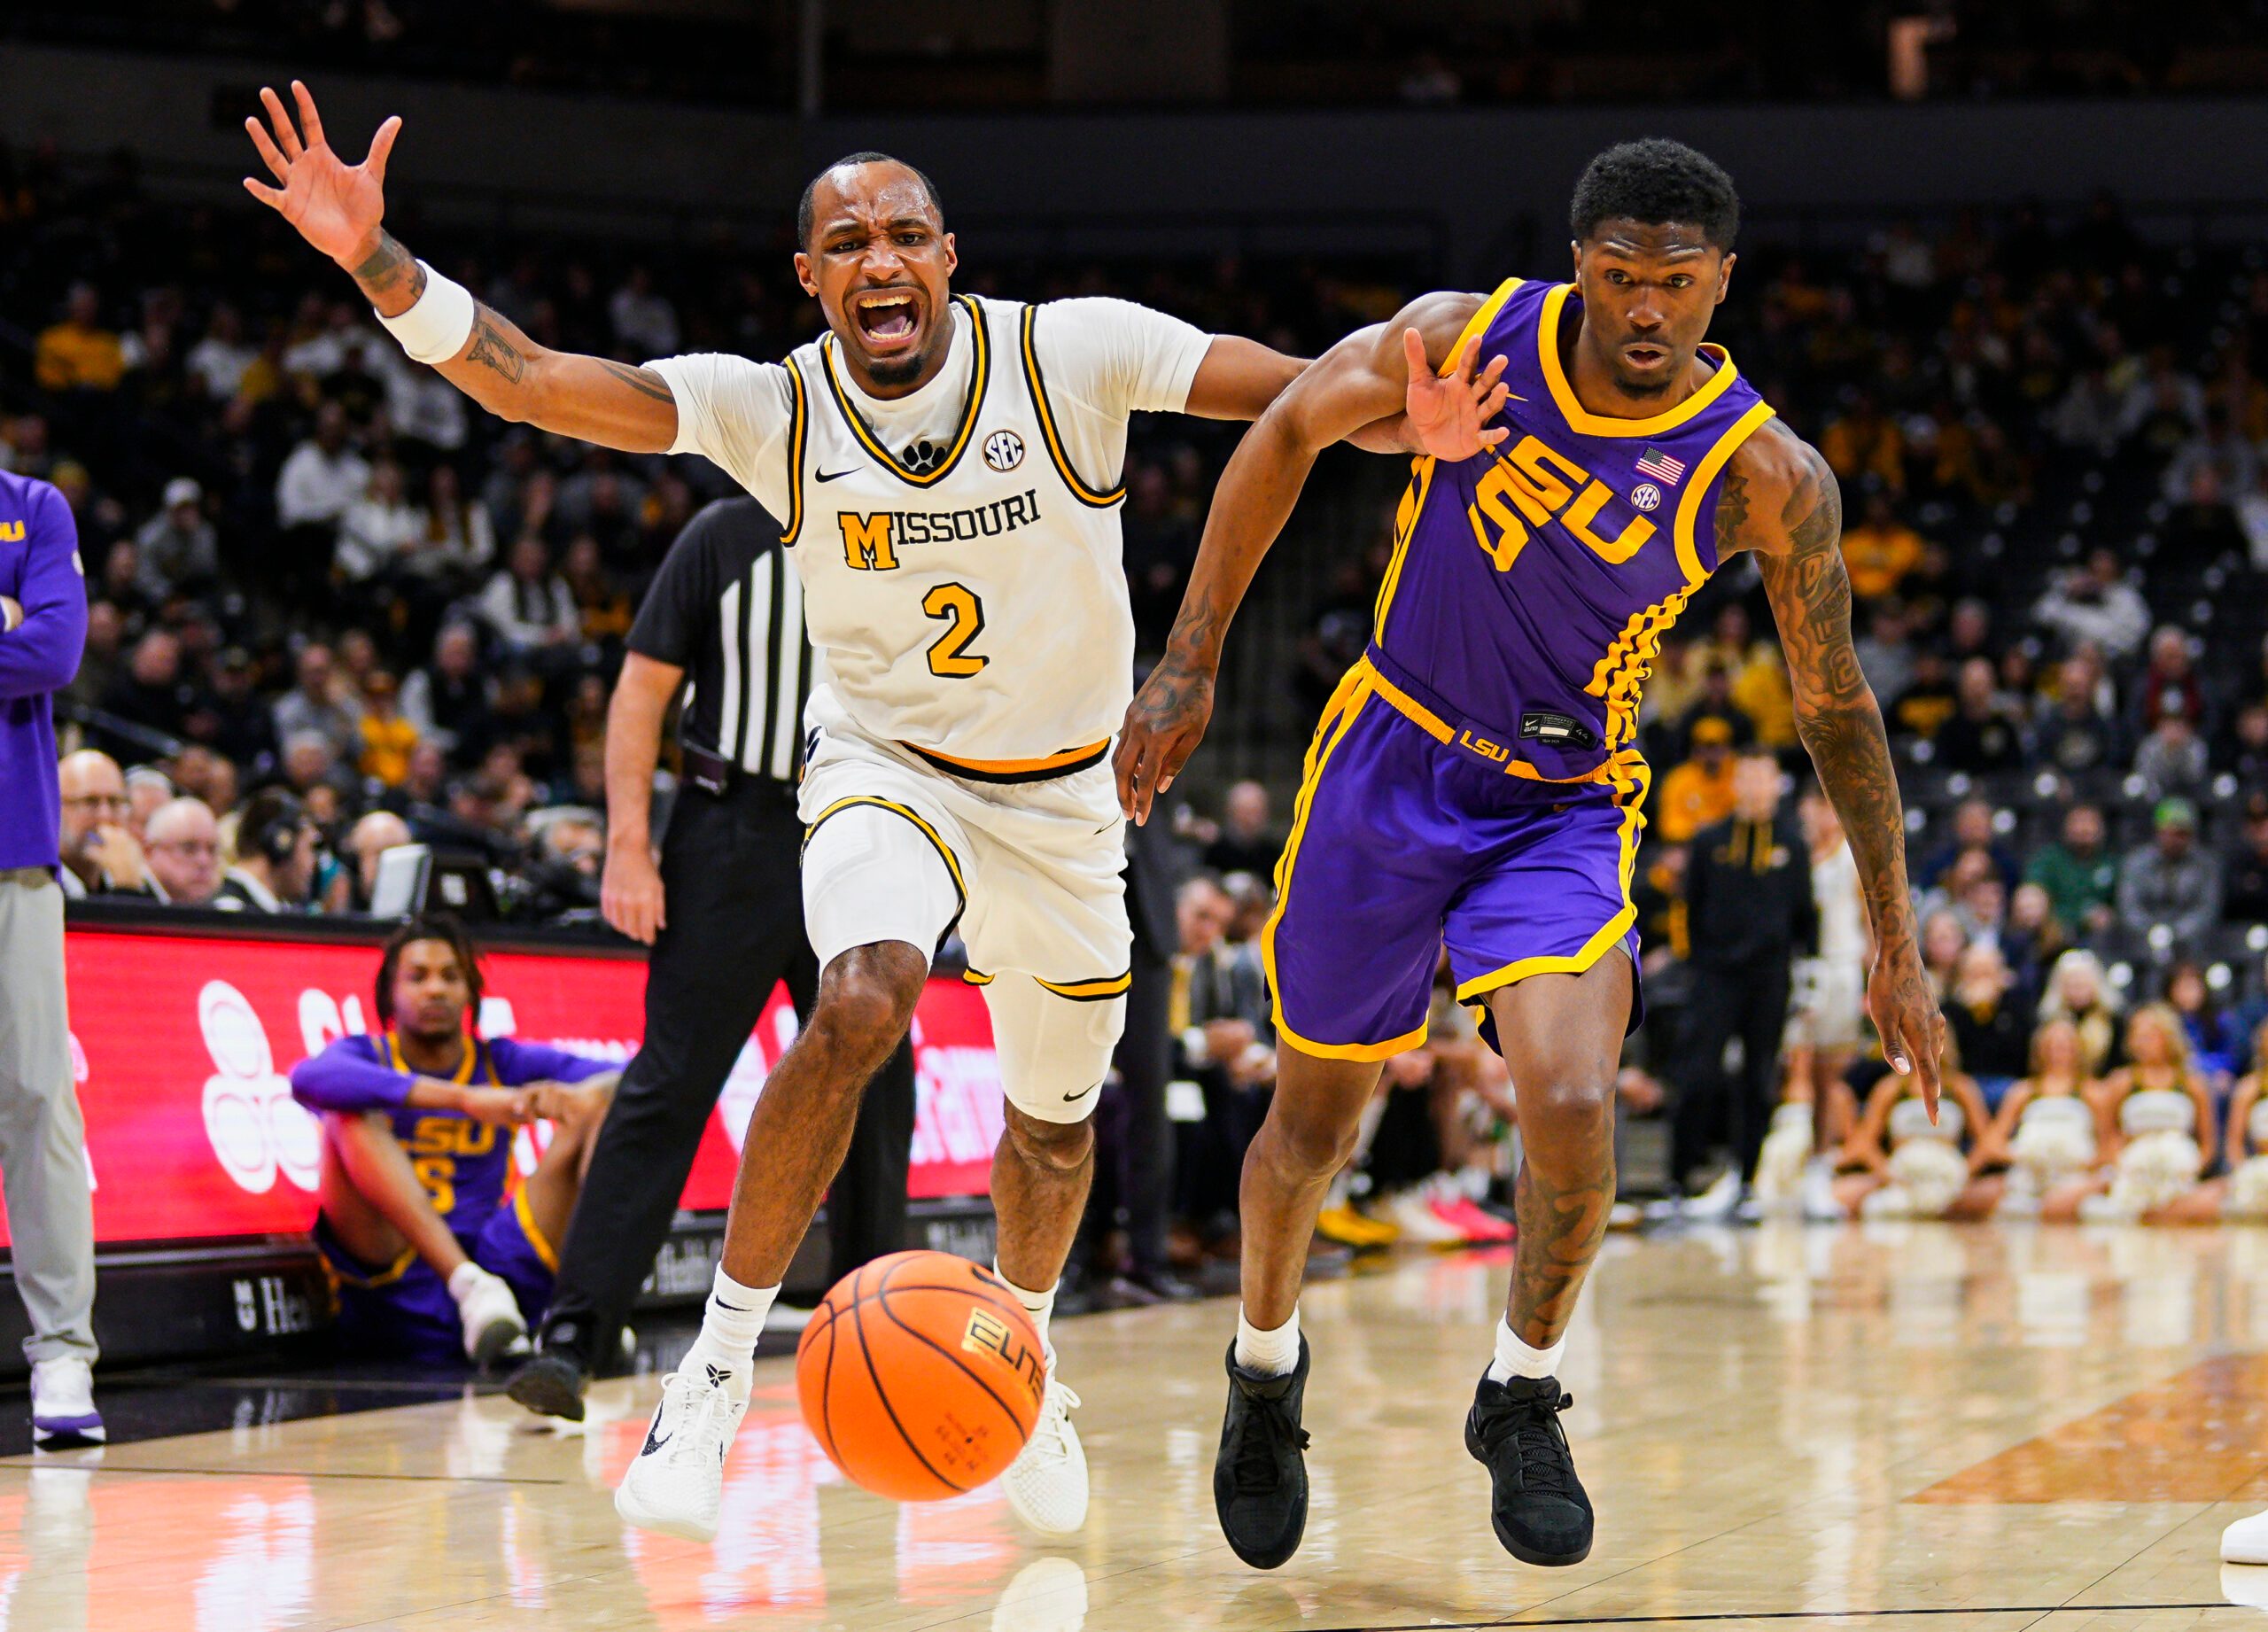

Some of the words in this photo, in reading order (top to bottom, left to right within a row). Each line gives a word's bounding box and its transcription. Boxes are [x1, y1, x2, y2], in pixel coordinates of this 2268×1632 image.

[983, 431, 1023, 470] SEC
[1485, 435, 1658, 564] SU
[1633, 486, 1658, 509] SEC
[837, 489, 1042, 571] MISSOURI
[921, 581, 990, 680] 2
[1460, 729, 1510, 762] LSU
